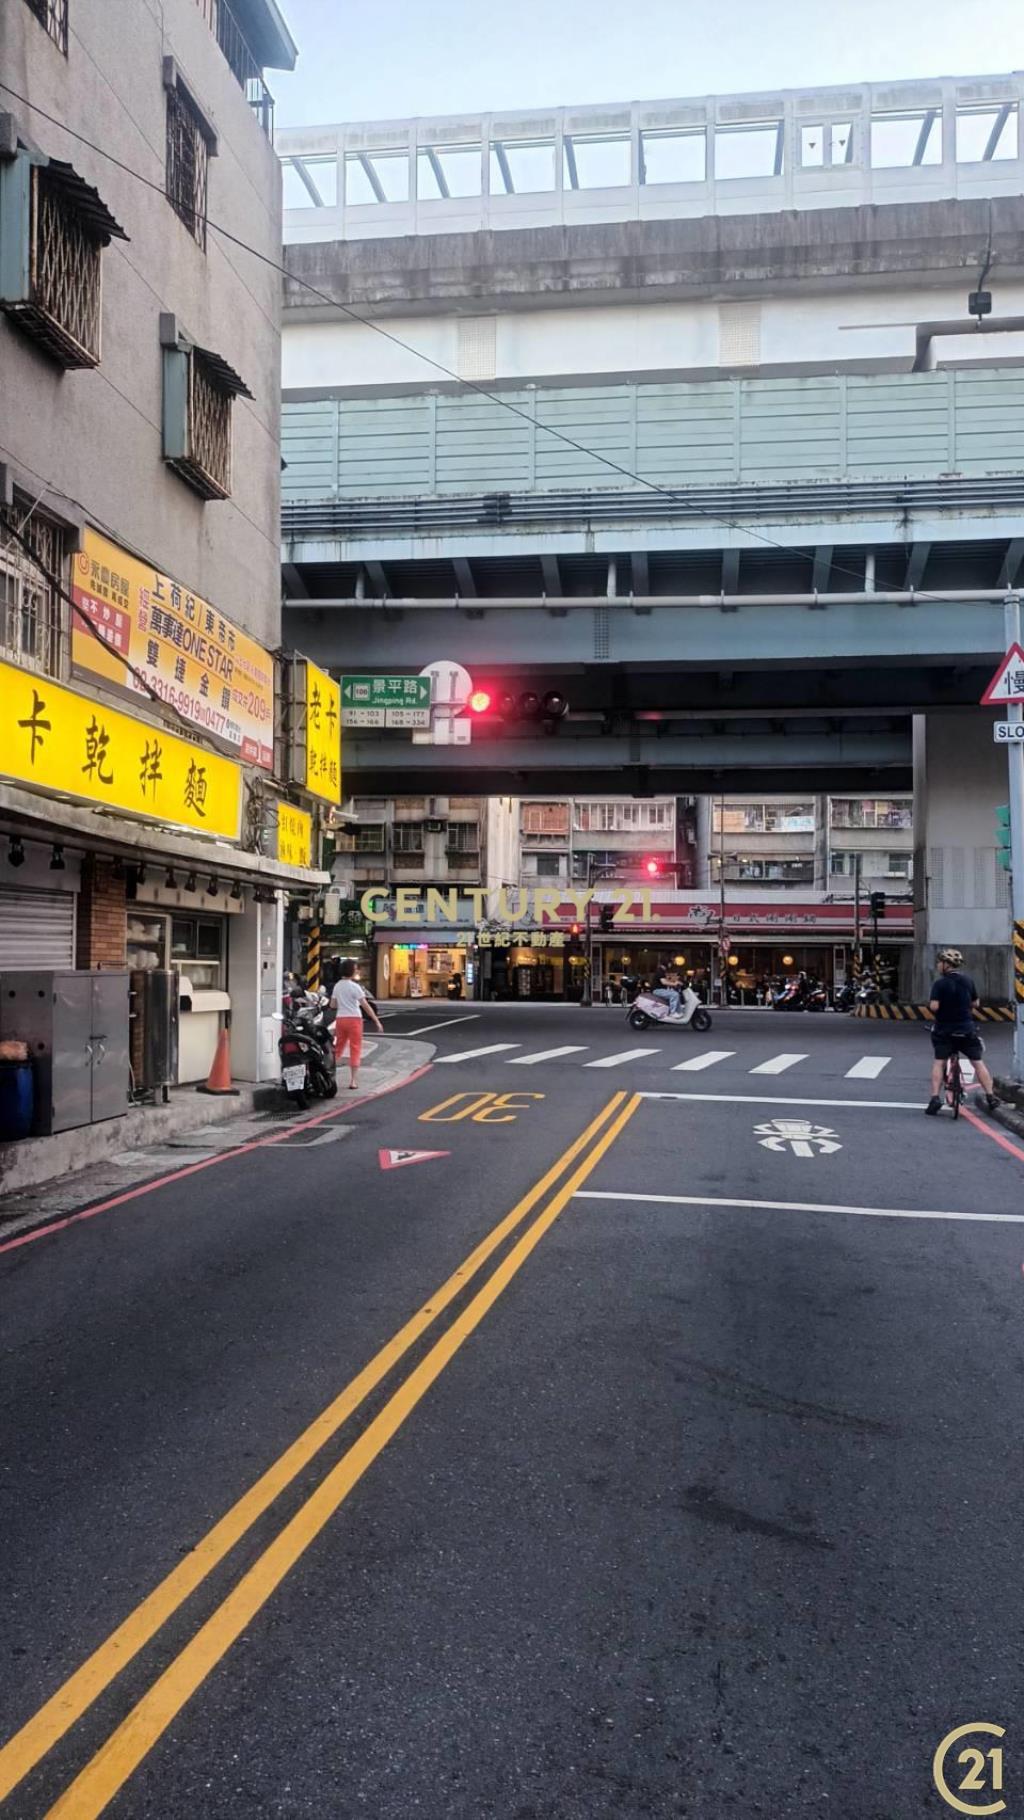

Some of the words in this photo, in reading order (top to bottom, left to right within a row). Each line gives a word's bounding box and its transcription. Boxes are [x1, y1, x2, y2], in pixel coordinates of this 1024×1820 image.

[207, 645, 234, 681] STAR
[372, 679, 417, 694] 景平路
[1004, 670, 1024, 695] 慢
[372, 697, 404, 706] Jingping
[18, 689, 207, 817] 卡乾拌麵
